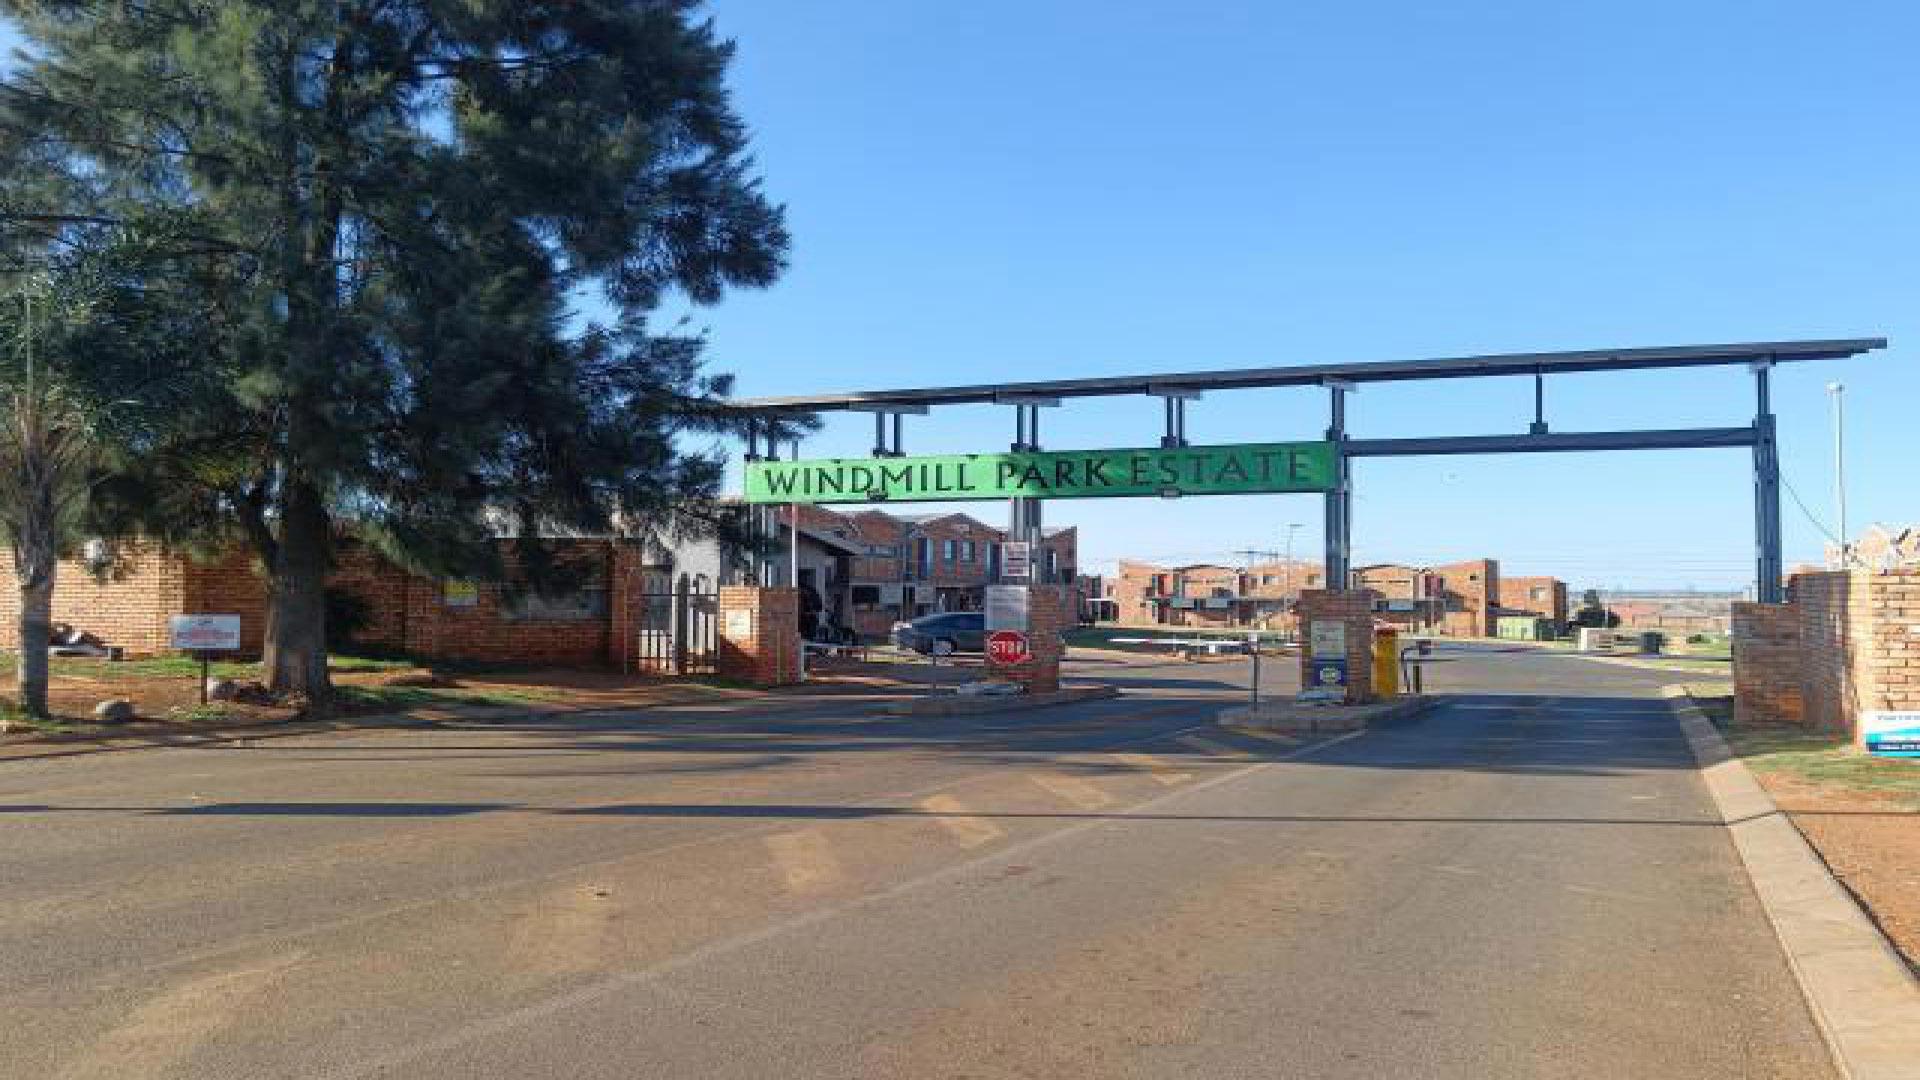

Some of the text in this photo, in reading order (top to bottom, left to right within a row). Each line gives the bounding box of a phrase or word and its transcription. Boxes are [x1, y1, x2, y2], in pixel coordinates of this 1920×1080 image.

[764, 452, 1310, 493] WINDMILL PARK ESTATE
[992, 640, 1023, 654] STOP
